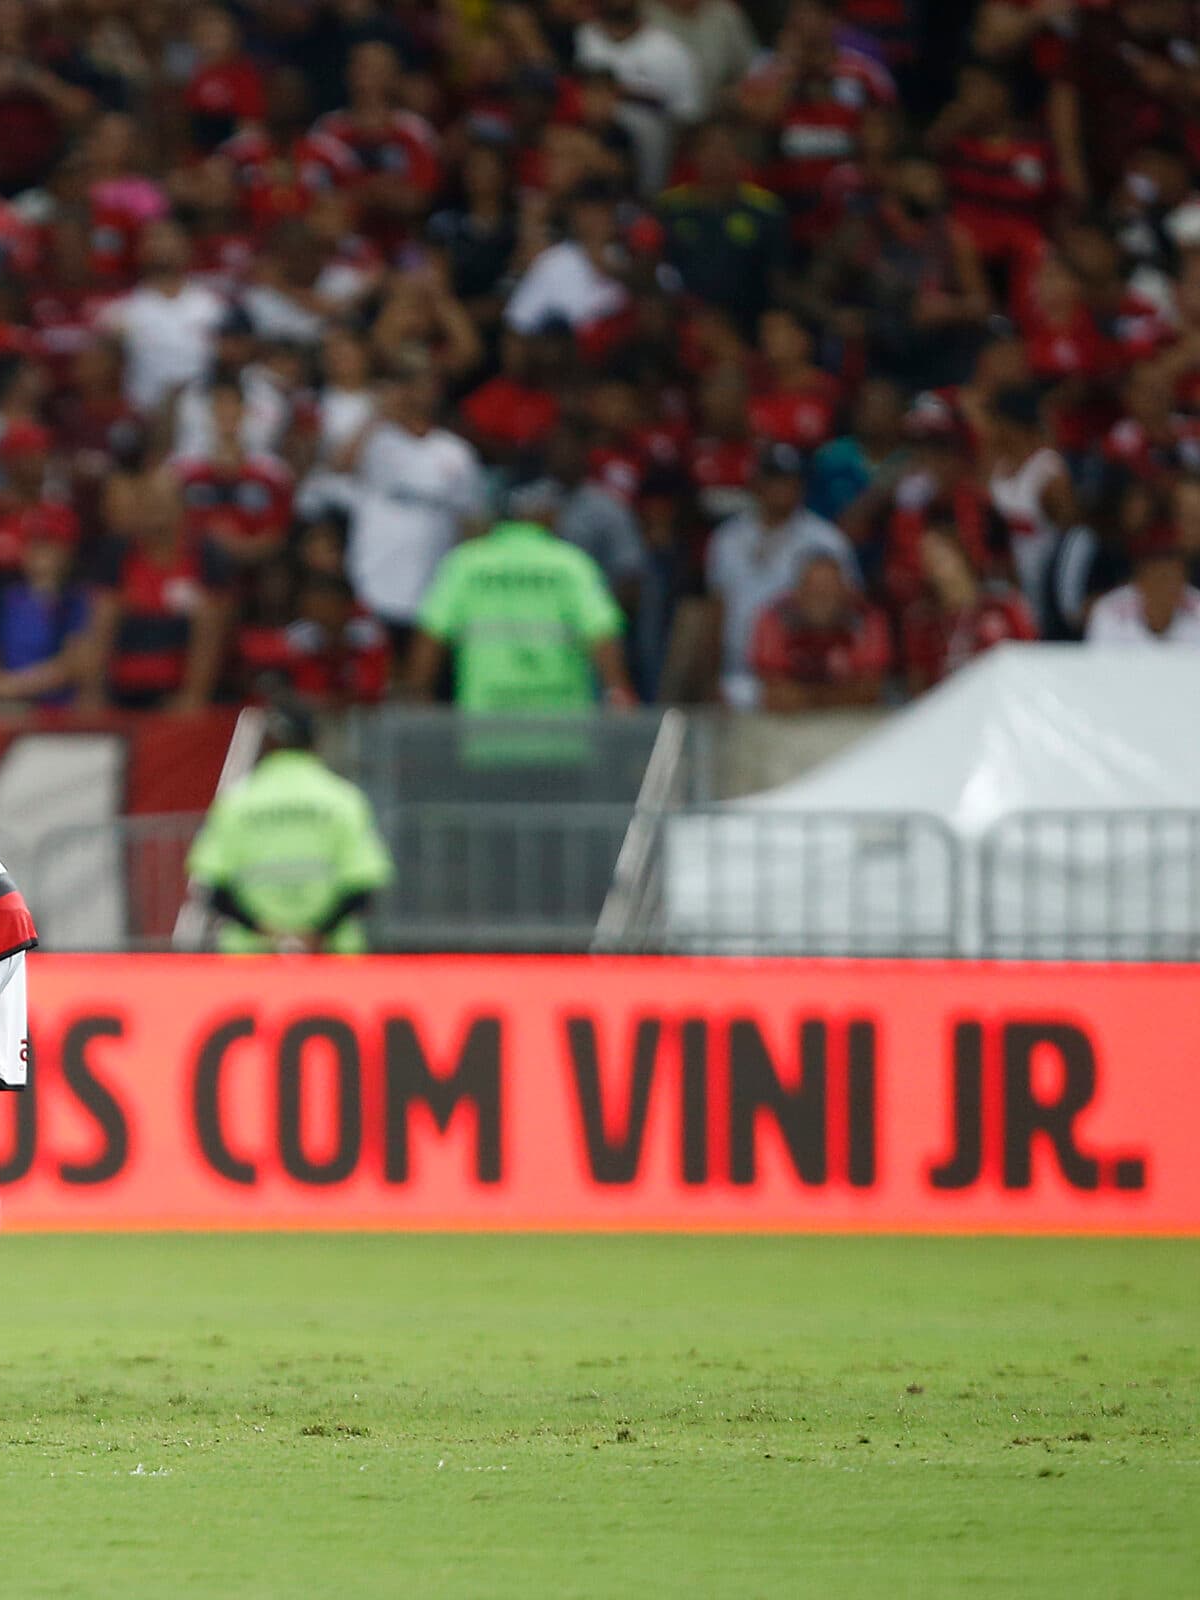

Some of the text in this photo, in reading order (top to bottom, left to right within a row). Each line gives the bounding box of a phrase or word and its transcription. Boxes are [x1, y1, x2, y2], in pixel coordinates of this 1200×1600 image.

[195, 1017, 501, 1185] COM
[568, 1017, 875, 1187] VINI
[930, 1020, 1145, 1190] JR.
